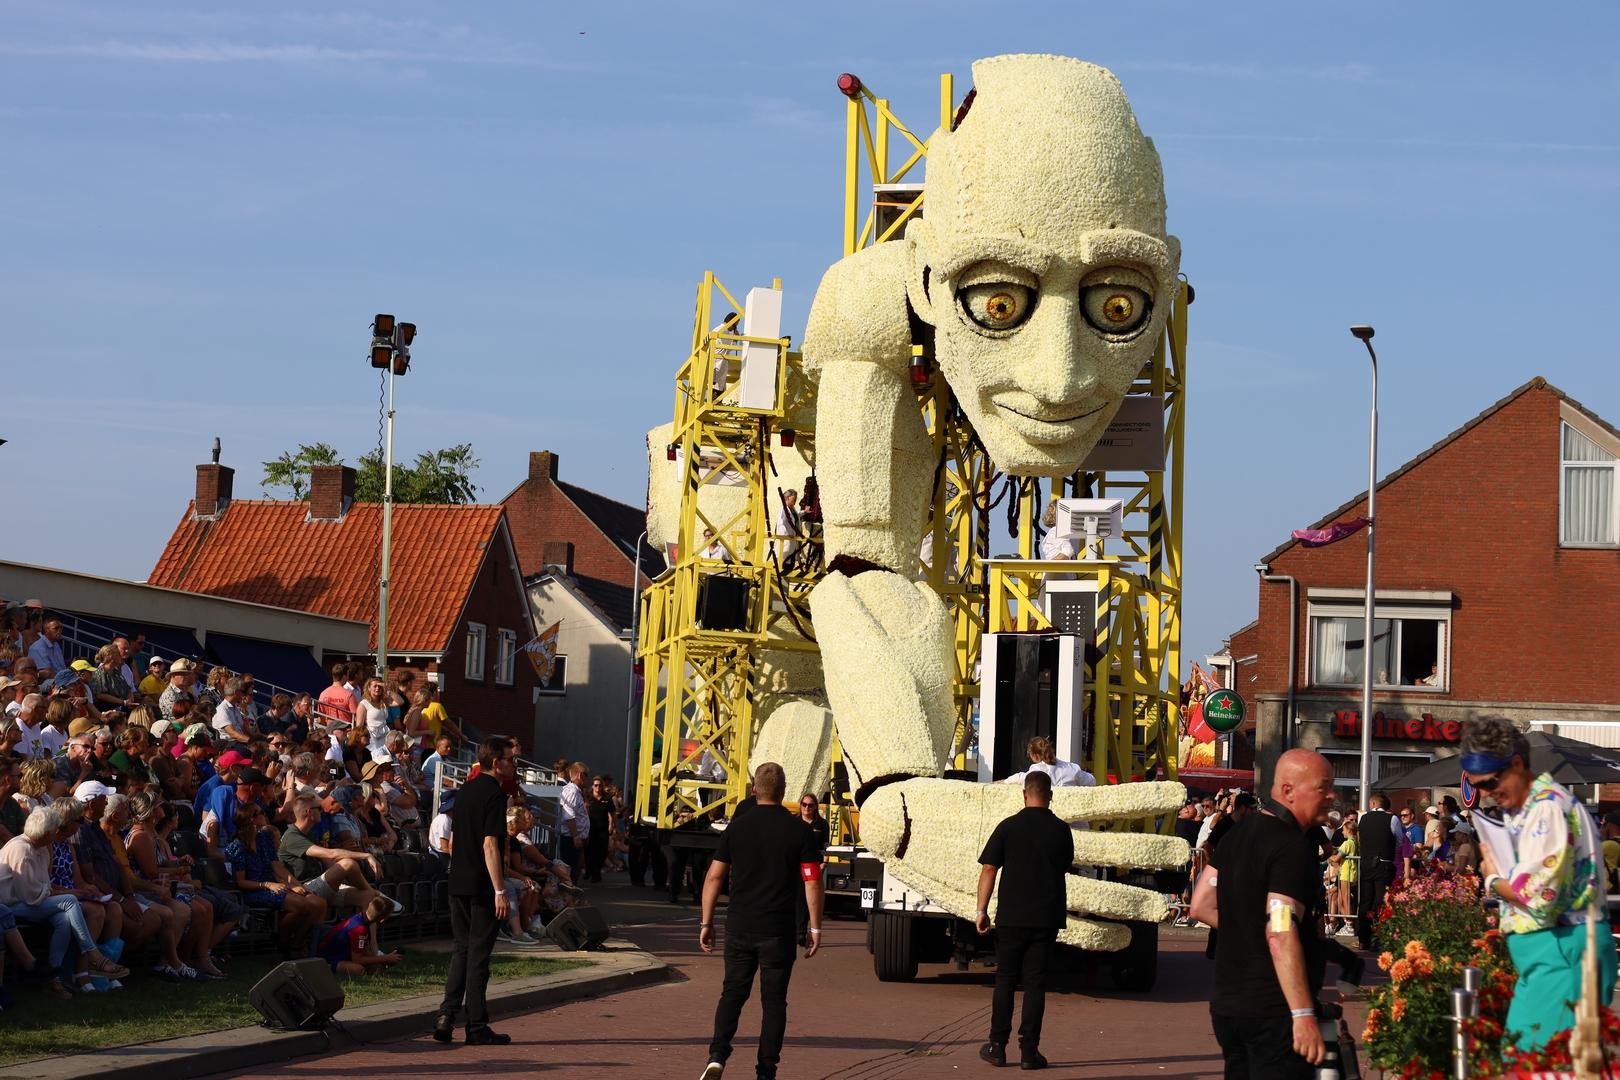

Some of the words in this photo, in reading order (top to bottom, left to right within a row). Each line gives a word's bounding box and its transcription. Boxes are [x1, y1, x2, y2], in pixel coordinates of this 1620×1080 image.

[1208, 710, 1241, 720] Heineken
[1334, 711, 1466, 740] Hineke
[862, 890, 873, 901] 03
